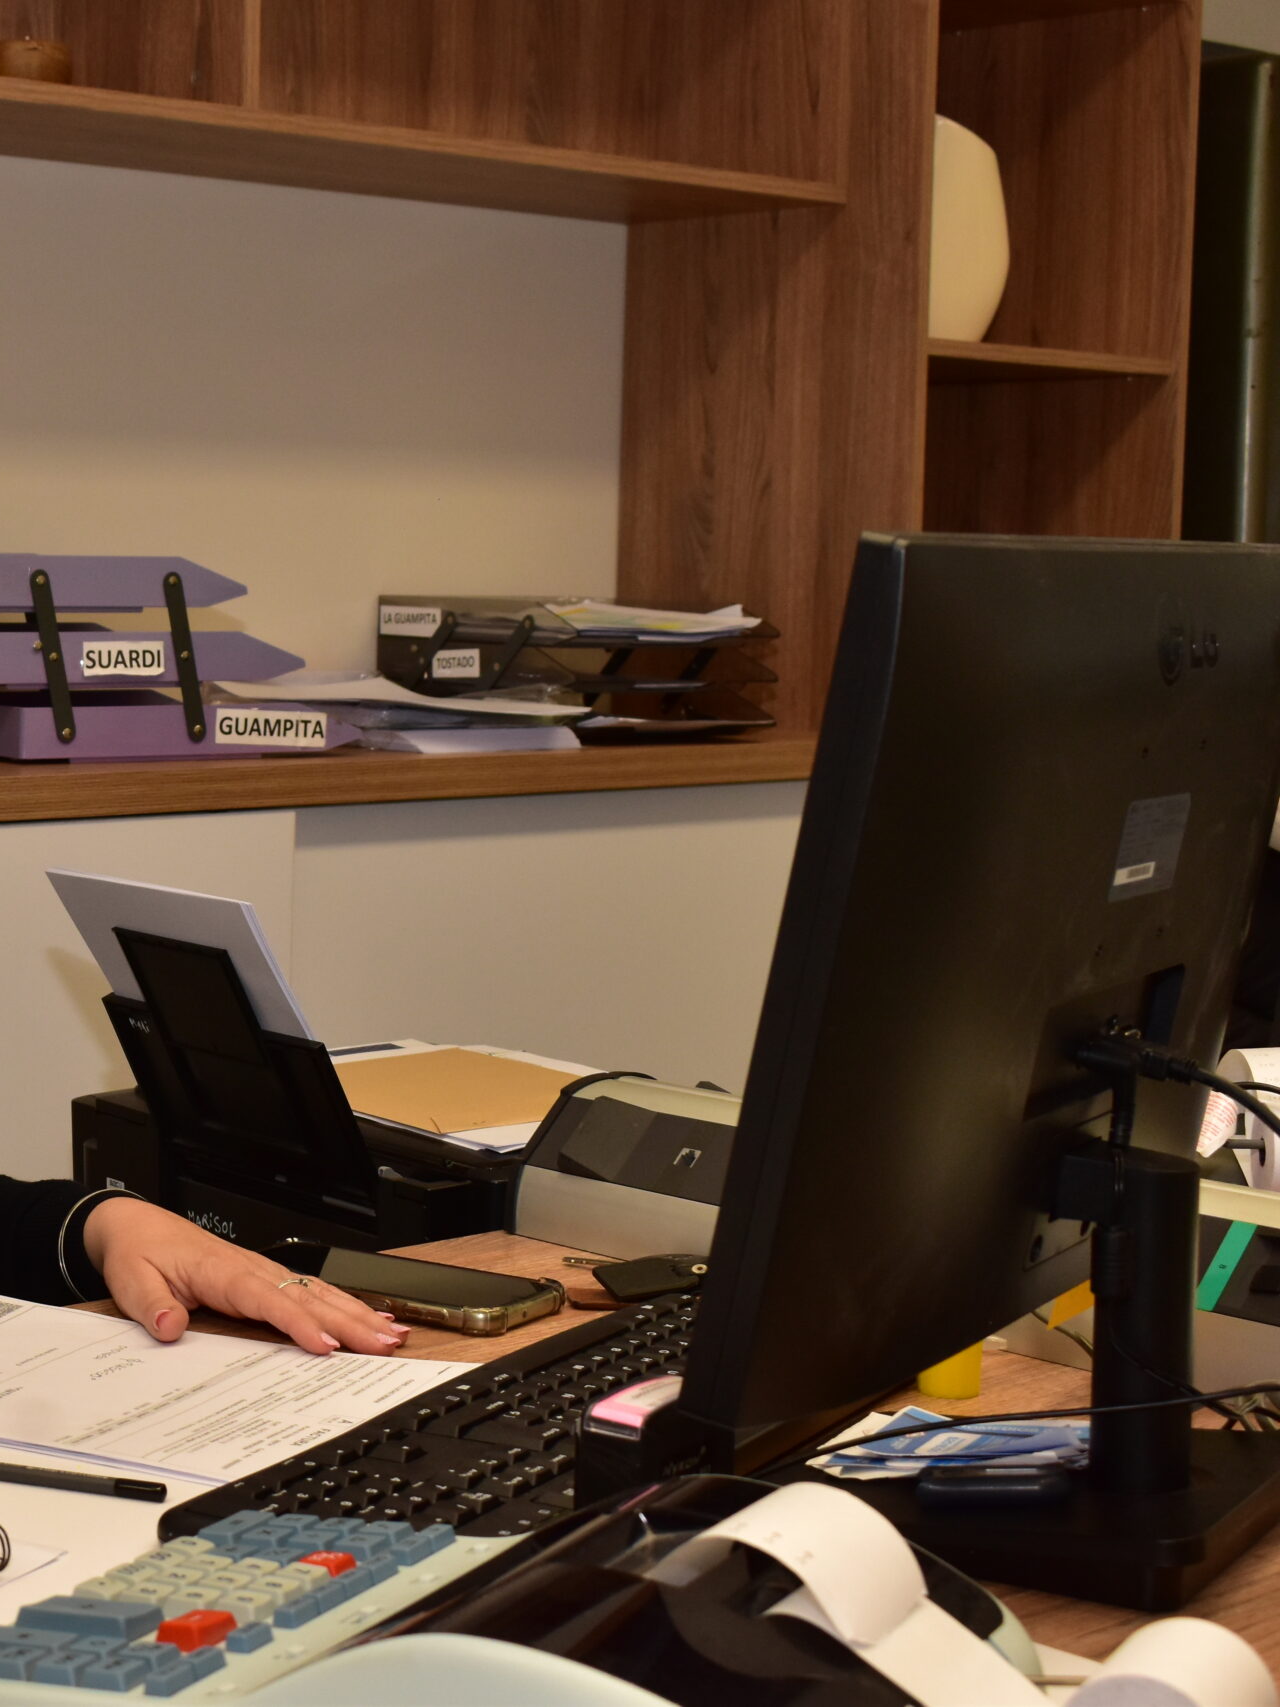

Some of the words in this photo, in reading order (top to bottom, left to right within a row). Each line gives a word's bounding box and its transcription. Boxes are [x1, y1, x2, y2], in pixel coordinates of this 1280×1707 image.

[383, 612, 394, 624] LA
[395, 612, 438, 625] GUAMPITA
[84, 649, 163, 671] SUARDI
[436, 655, 475, 671] TOSTADO
[218, 715, 326, 741] GUAMPITA
[290, 1427, 331, 1448] FACTURA
